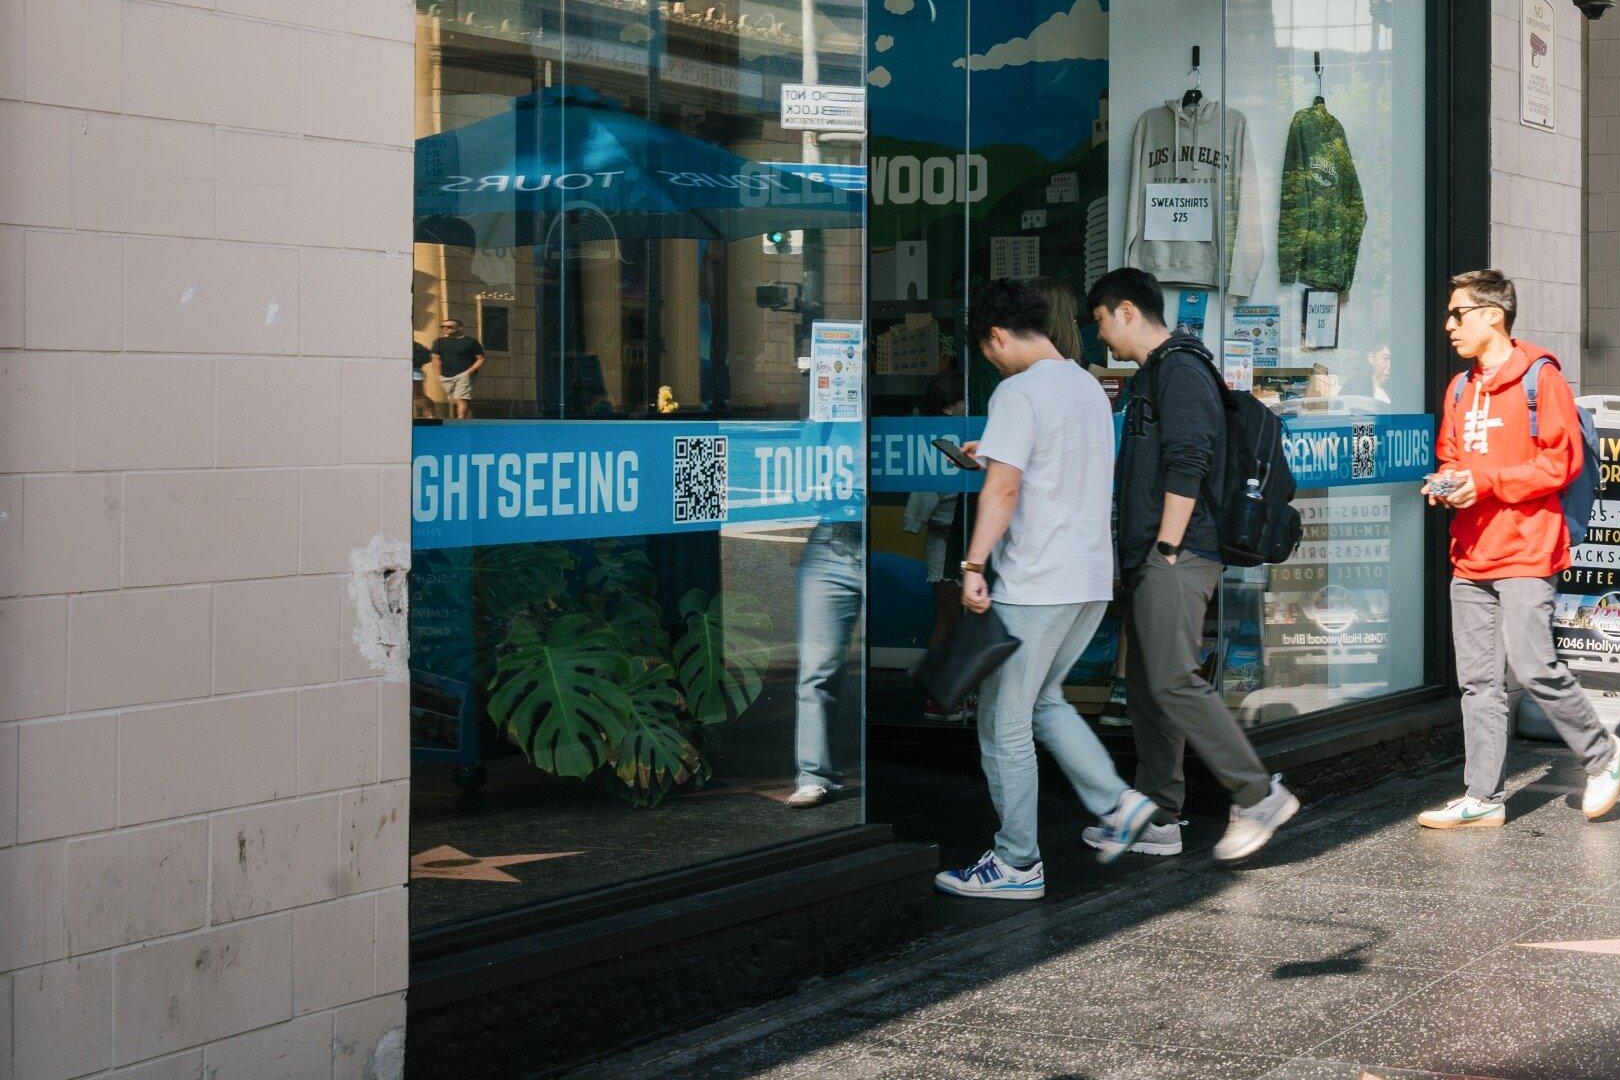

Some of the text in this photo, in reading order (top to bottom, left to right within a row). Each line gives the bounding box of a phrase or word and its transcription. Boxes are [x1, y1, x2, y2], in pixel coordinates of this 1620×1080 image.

[1148, 146, 1169, 169] LOS
[1150, 196, 1209, 209] SWEATSHIRTS
[1172, 211, 1189, 224] $25
[1386, 429, 1430, 468] TOURS
[413, 443, 854, 523] GHTSEEING TOURS
[1574, 549, 1617, 564] ACKS
[1562, 570, 1615, 586] OFFEE
[1556, 636, 1585, 651] 7046
